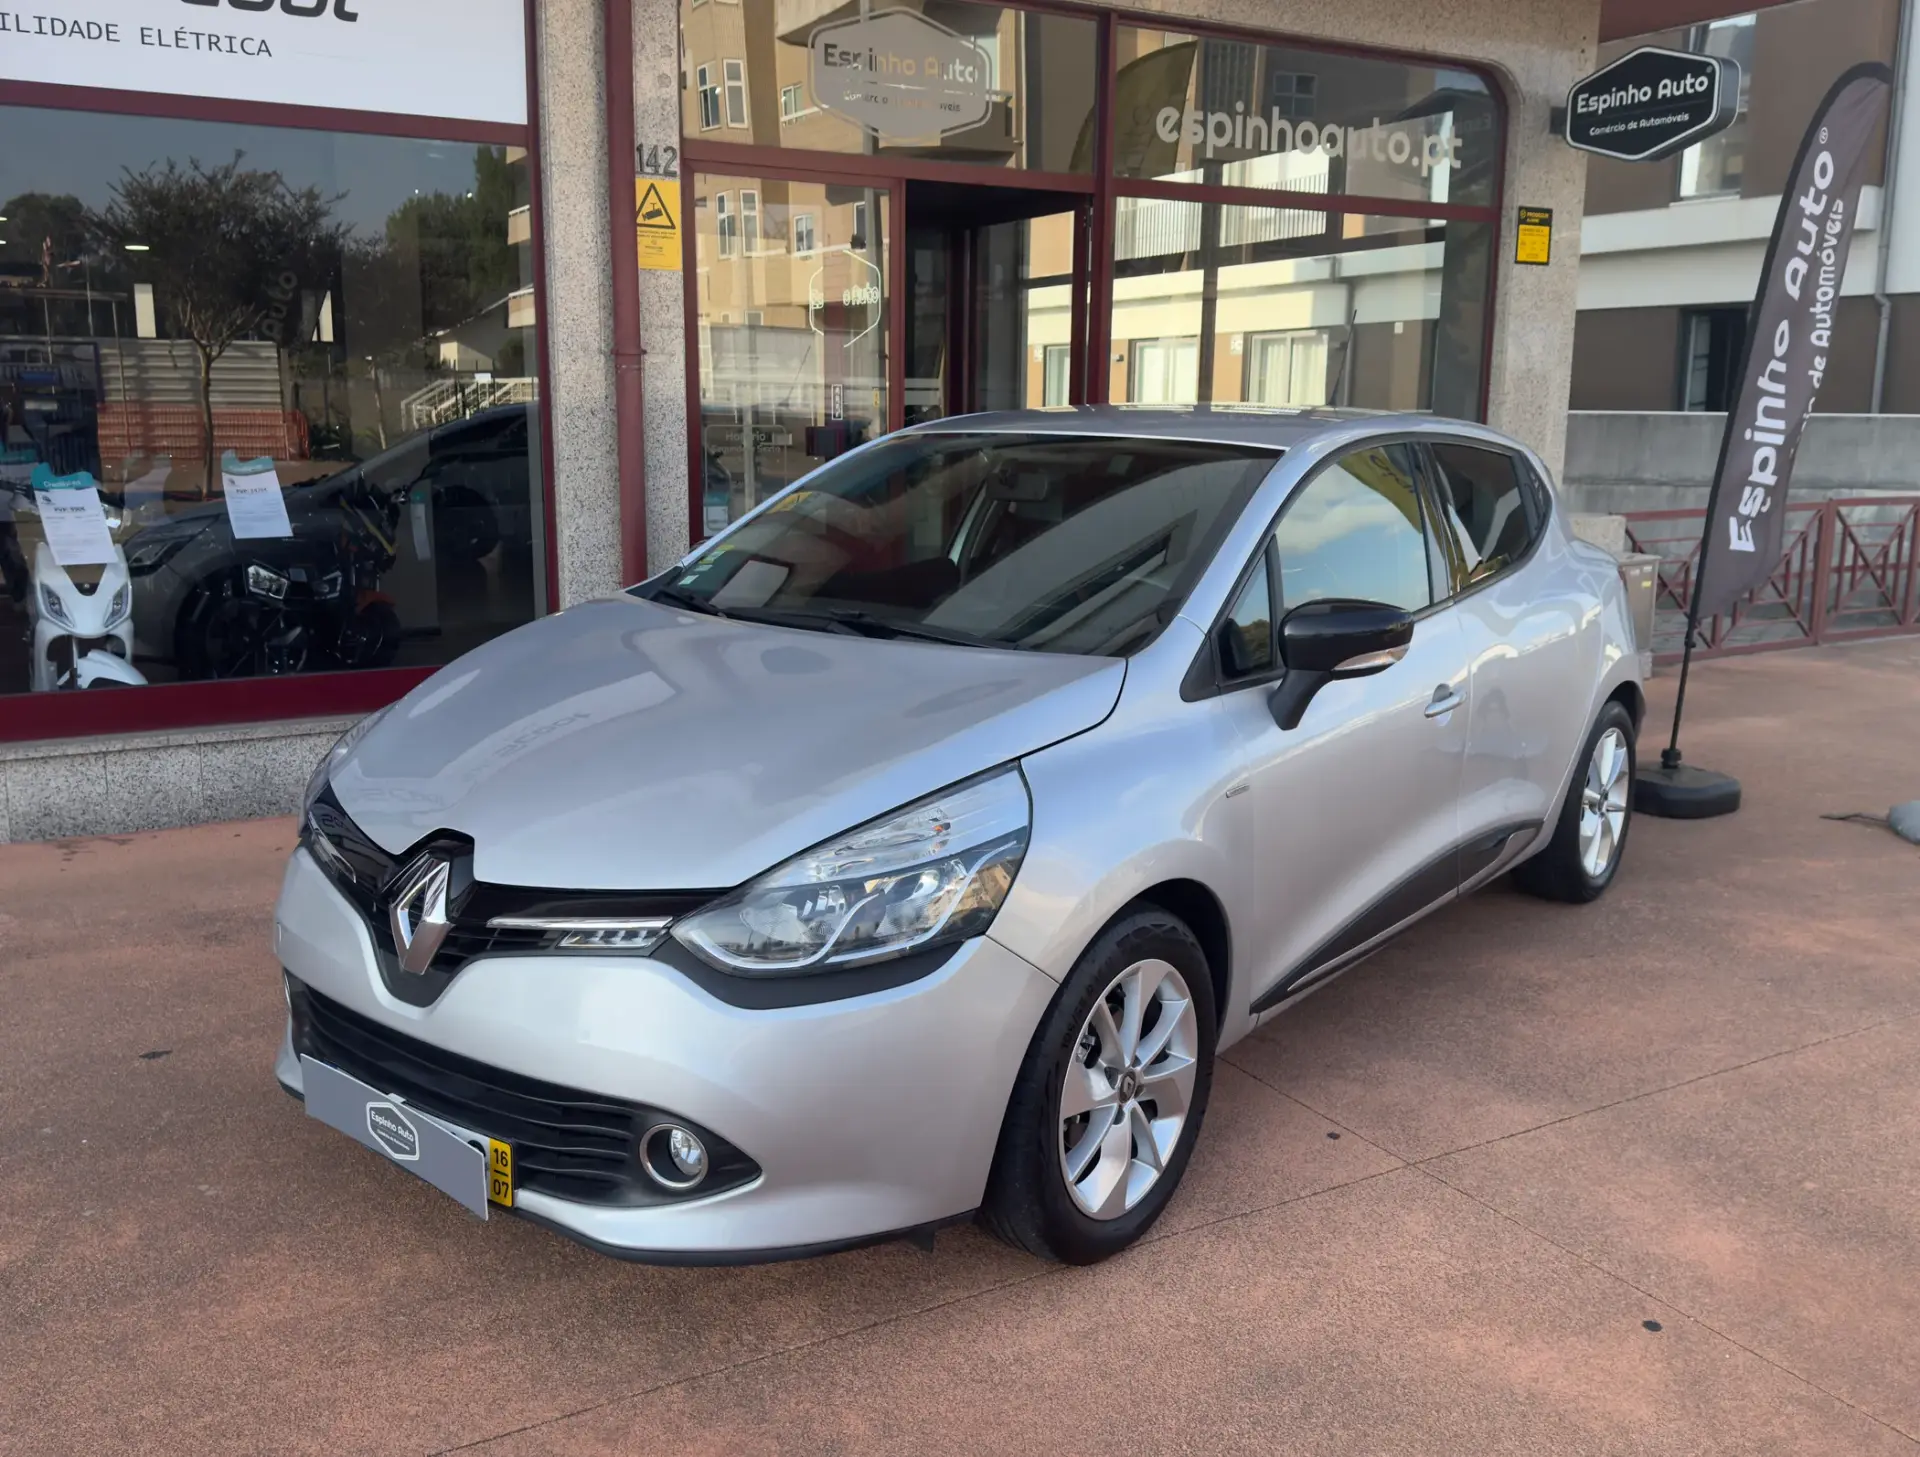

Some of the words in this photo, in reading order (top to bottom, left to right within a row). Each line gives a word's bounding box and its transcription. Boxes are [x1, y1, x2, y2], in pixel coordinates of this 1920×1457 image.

[140, 26, 273, 58] ELÉTRICA
[1576, 84, 1653, 115] Espinho
[1657, 73, 1709, 100] Auto
[1155, 100, 1463, 178] espinhoauto.pt
[1588, 121, 1627, 137] Comércio
[1627, 120, 1638, 131] de
[1639, 111, 1690, 128] Automóveis
[637, 143, 678, 178] 142
[1809, 199, 1845, 348] Automóveis
[1728, 318, 1790, 553] Espinho
[1784, 150, 1834, 301] Auto
[1808, 355, 1827, 389] de
[371, 1110, 397, 1132] Espinho
[397, 1126, 414, 1142] Auto
[493, 1148, 509, 1167] 16
[493, 1179, 509, 1198] 07
